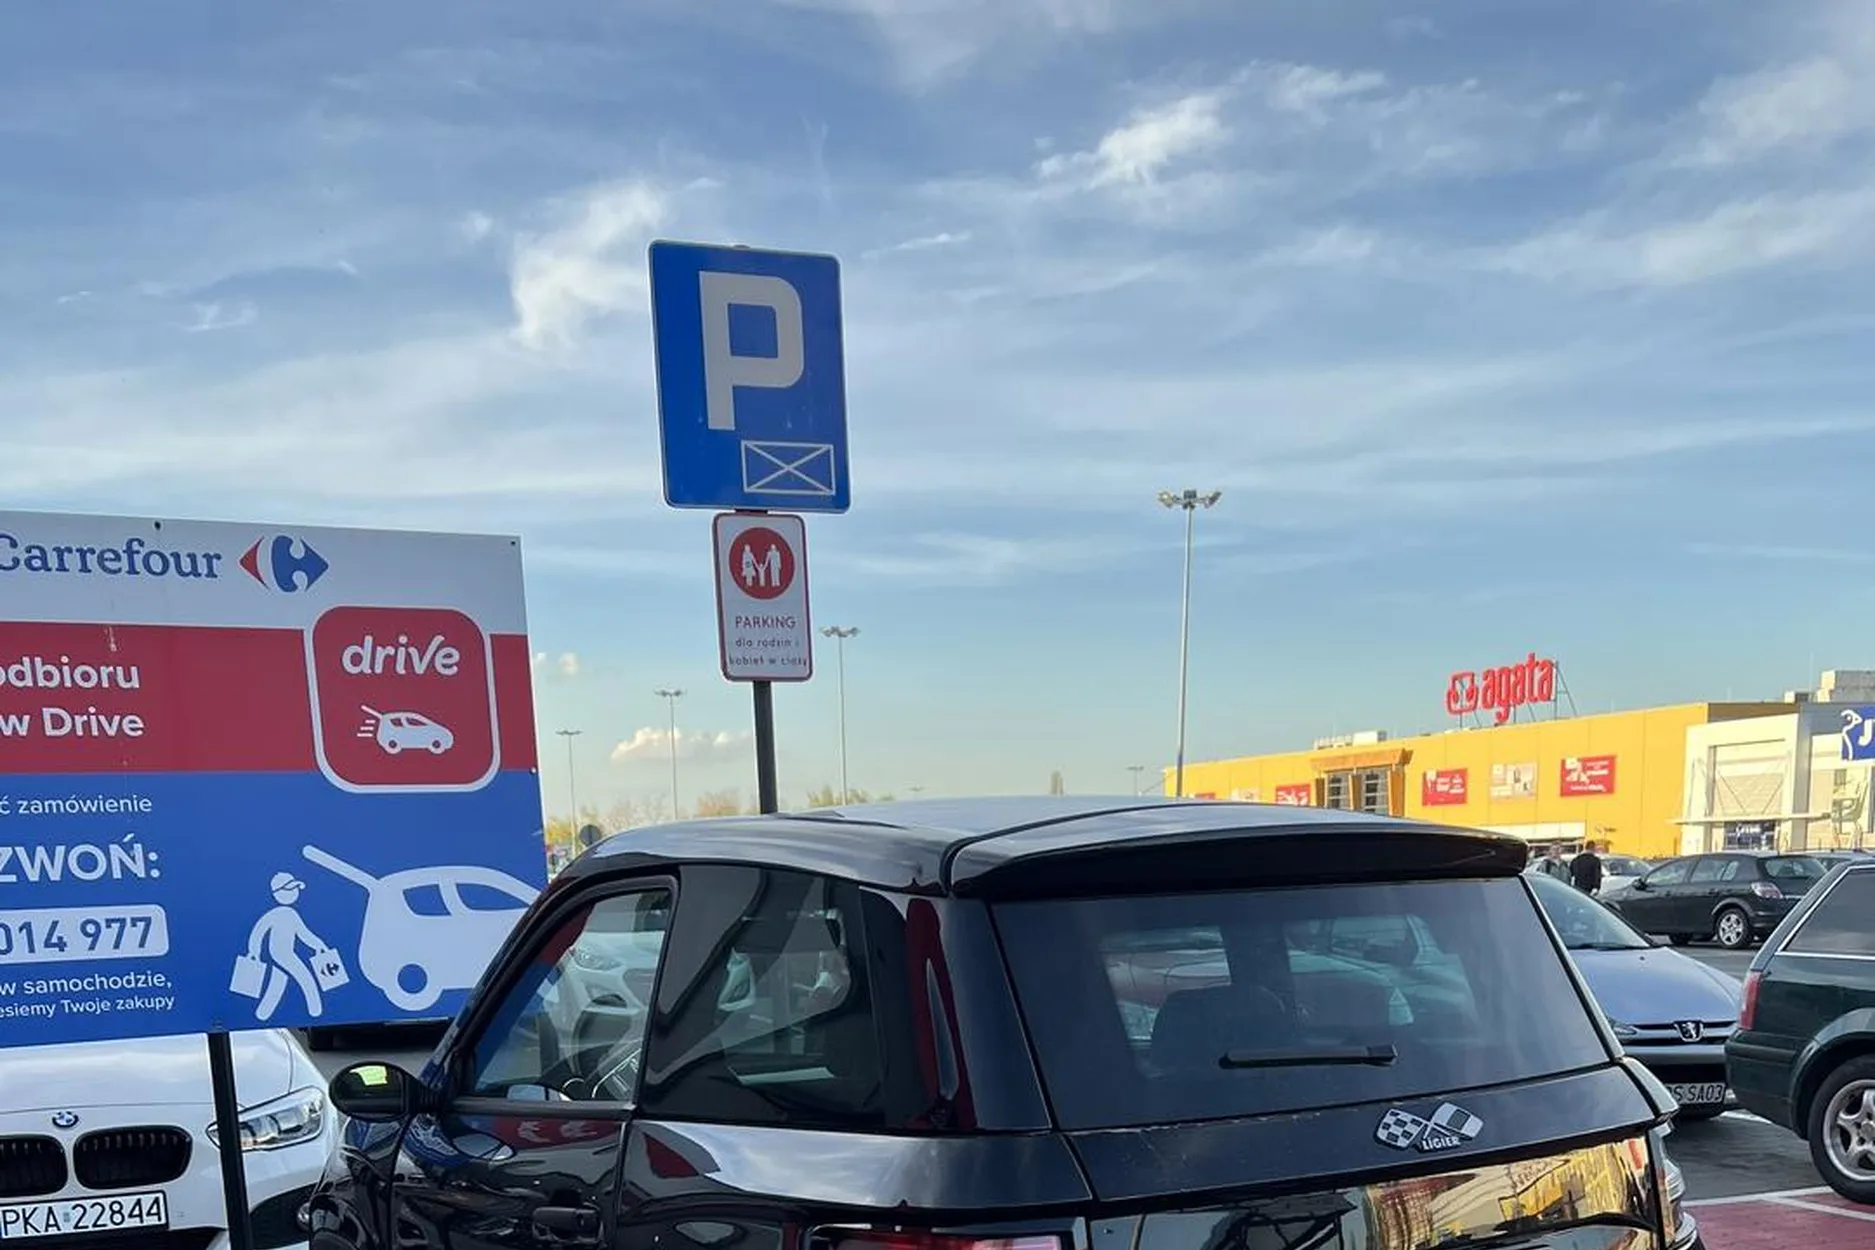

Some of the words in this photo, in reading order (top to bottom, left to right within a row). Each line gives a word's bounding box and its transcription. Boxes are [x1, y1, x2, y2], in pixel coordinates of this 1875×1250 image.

[699, 270, 804, 430] P
[0, 533, 222, 580] Carrefour
[735, 615, 797, 629] PARKING
[342, 634, 460, 676] drive
[735, 637, 753, 648] dla
[0, 655, 140, 689] dbioru
[1481, 652, 1555, 724] agata
[42, 706, 144, 737] Drive
[18, 794, 153, 814] zamówienie
[79, 916, 152, 951] 977
[23, 970, 172, 995] samochodzie,
[60, 996, 112, 1015] Twoje
[116, 995, 175, 1011] zakupy
[1421, 1136, 1461, 1151] LIGIER
[1, 1204, 62, 1237] PKA
[71, 1195, 163, 1231] 22844
